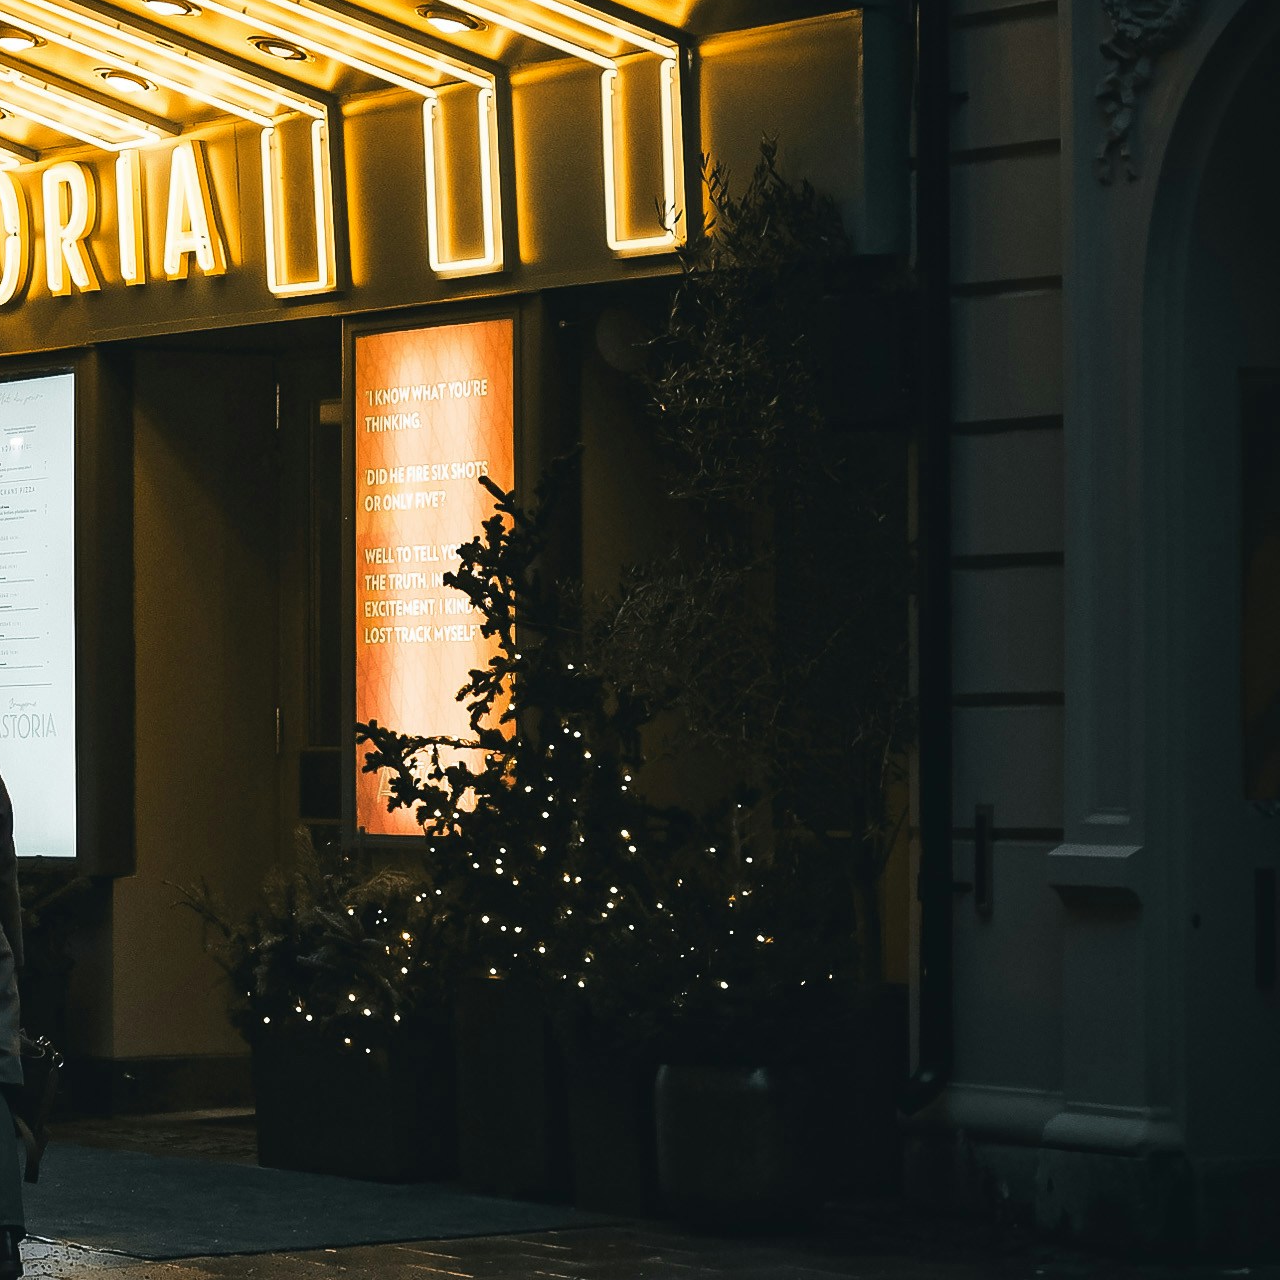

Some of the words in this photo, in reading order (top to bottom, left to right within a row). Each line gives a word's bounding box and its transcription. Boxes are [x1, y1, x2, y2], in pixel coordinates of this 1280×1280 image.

[375, 386, 410, 406] KNOW
[411, 383, 446, 401] WHAT
[448, 379, 488, 399] YOU'RE
[389, 466, 405, 484] HE
[406, 464, 430, 482] FIRE
[431, 463, 450, 481] SIX
[451, 460, 489, 479] SHOTS
[365, 495, 382, 512] OR
[383, 493, 414, 511] ONLY
[365, 548, 395, 565] WELL
[396, 546, 412, 563] TO
[413, 544, 439, 562] TELL
[365, 574, 387, 591] THE
[431, 571, 444, 588] IN
[445, 597, 474, 615] KIND
[365, 627, 393, 644] LOST
[394, 625, 433, 643] TRACK
